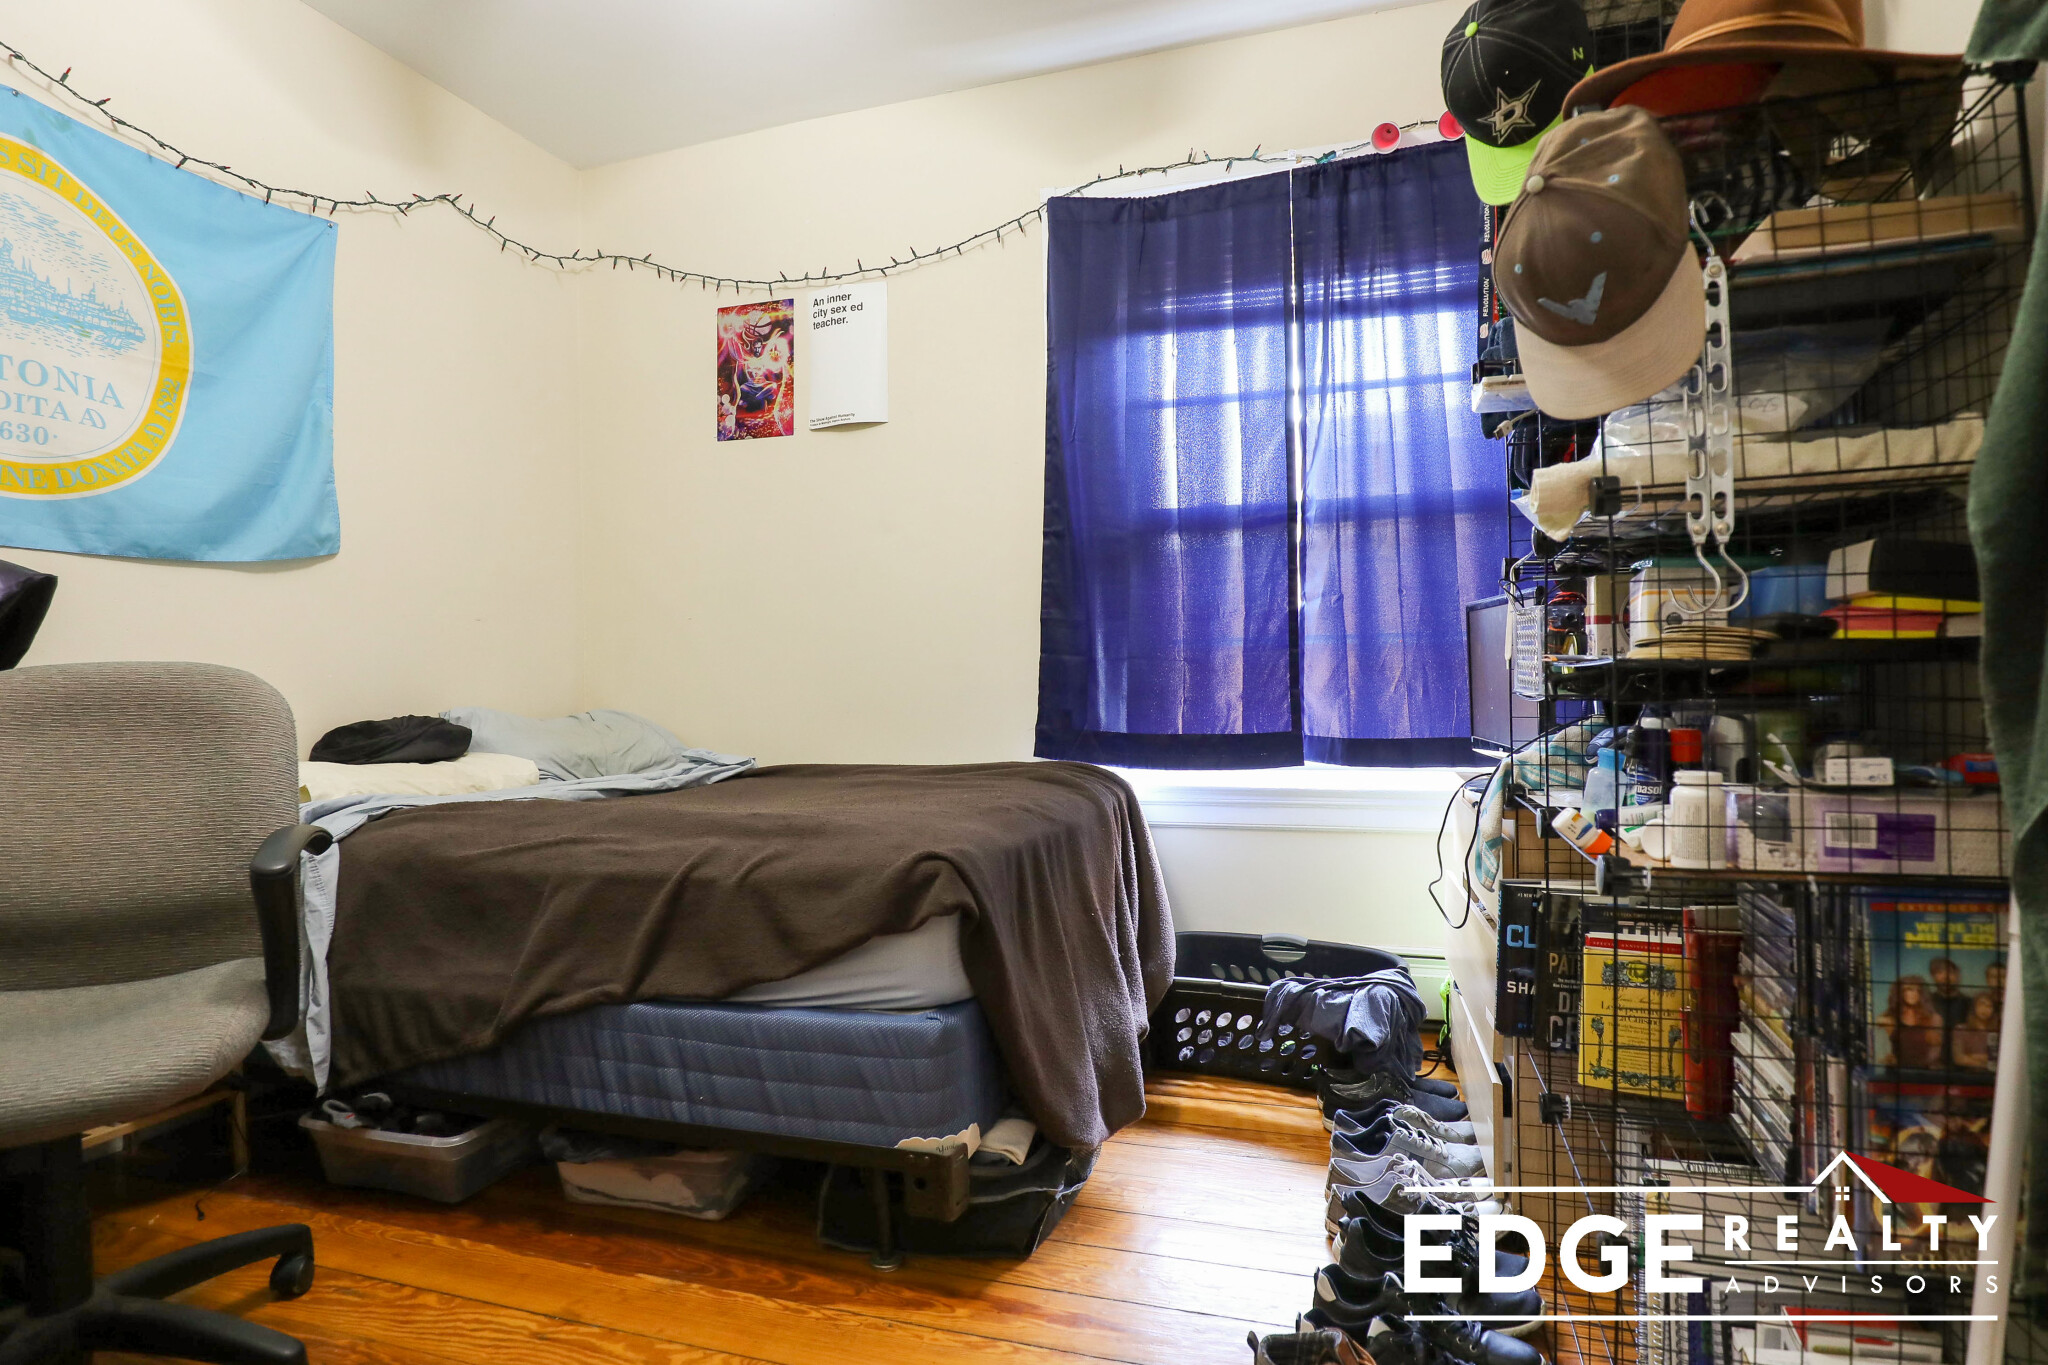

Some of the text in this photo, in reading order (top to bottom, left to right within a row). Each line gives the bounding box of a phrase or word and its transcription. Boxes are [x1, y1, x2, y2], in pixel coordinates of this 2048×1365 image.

[17, 152, 71, 192] SIT
[74, 190, 142, 258] DEUS
[812, 293, 852, 308] An inner
[812, 302, 863, 319] city sex ed
[812, 316, 849, 330] teacher.
[51, 441, 153, 489] DONATA
[155, 377, 182, 424] 1822
